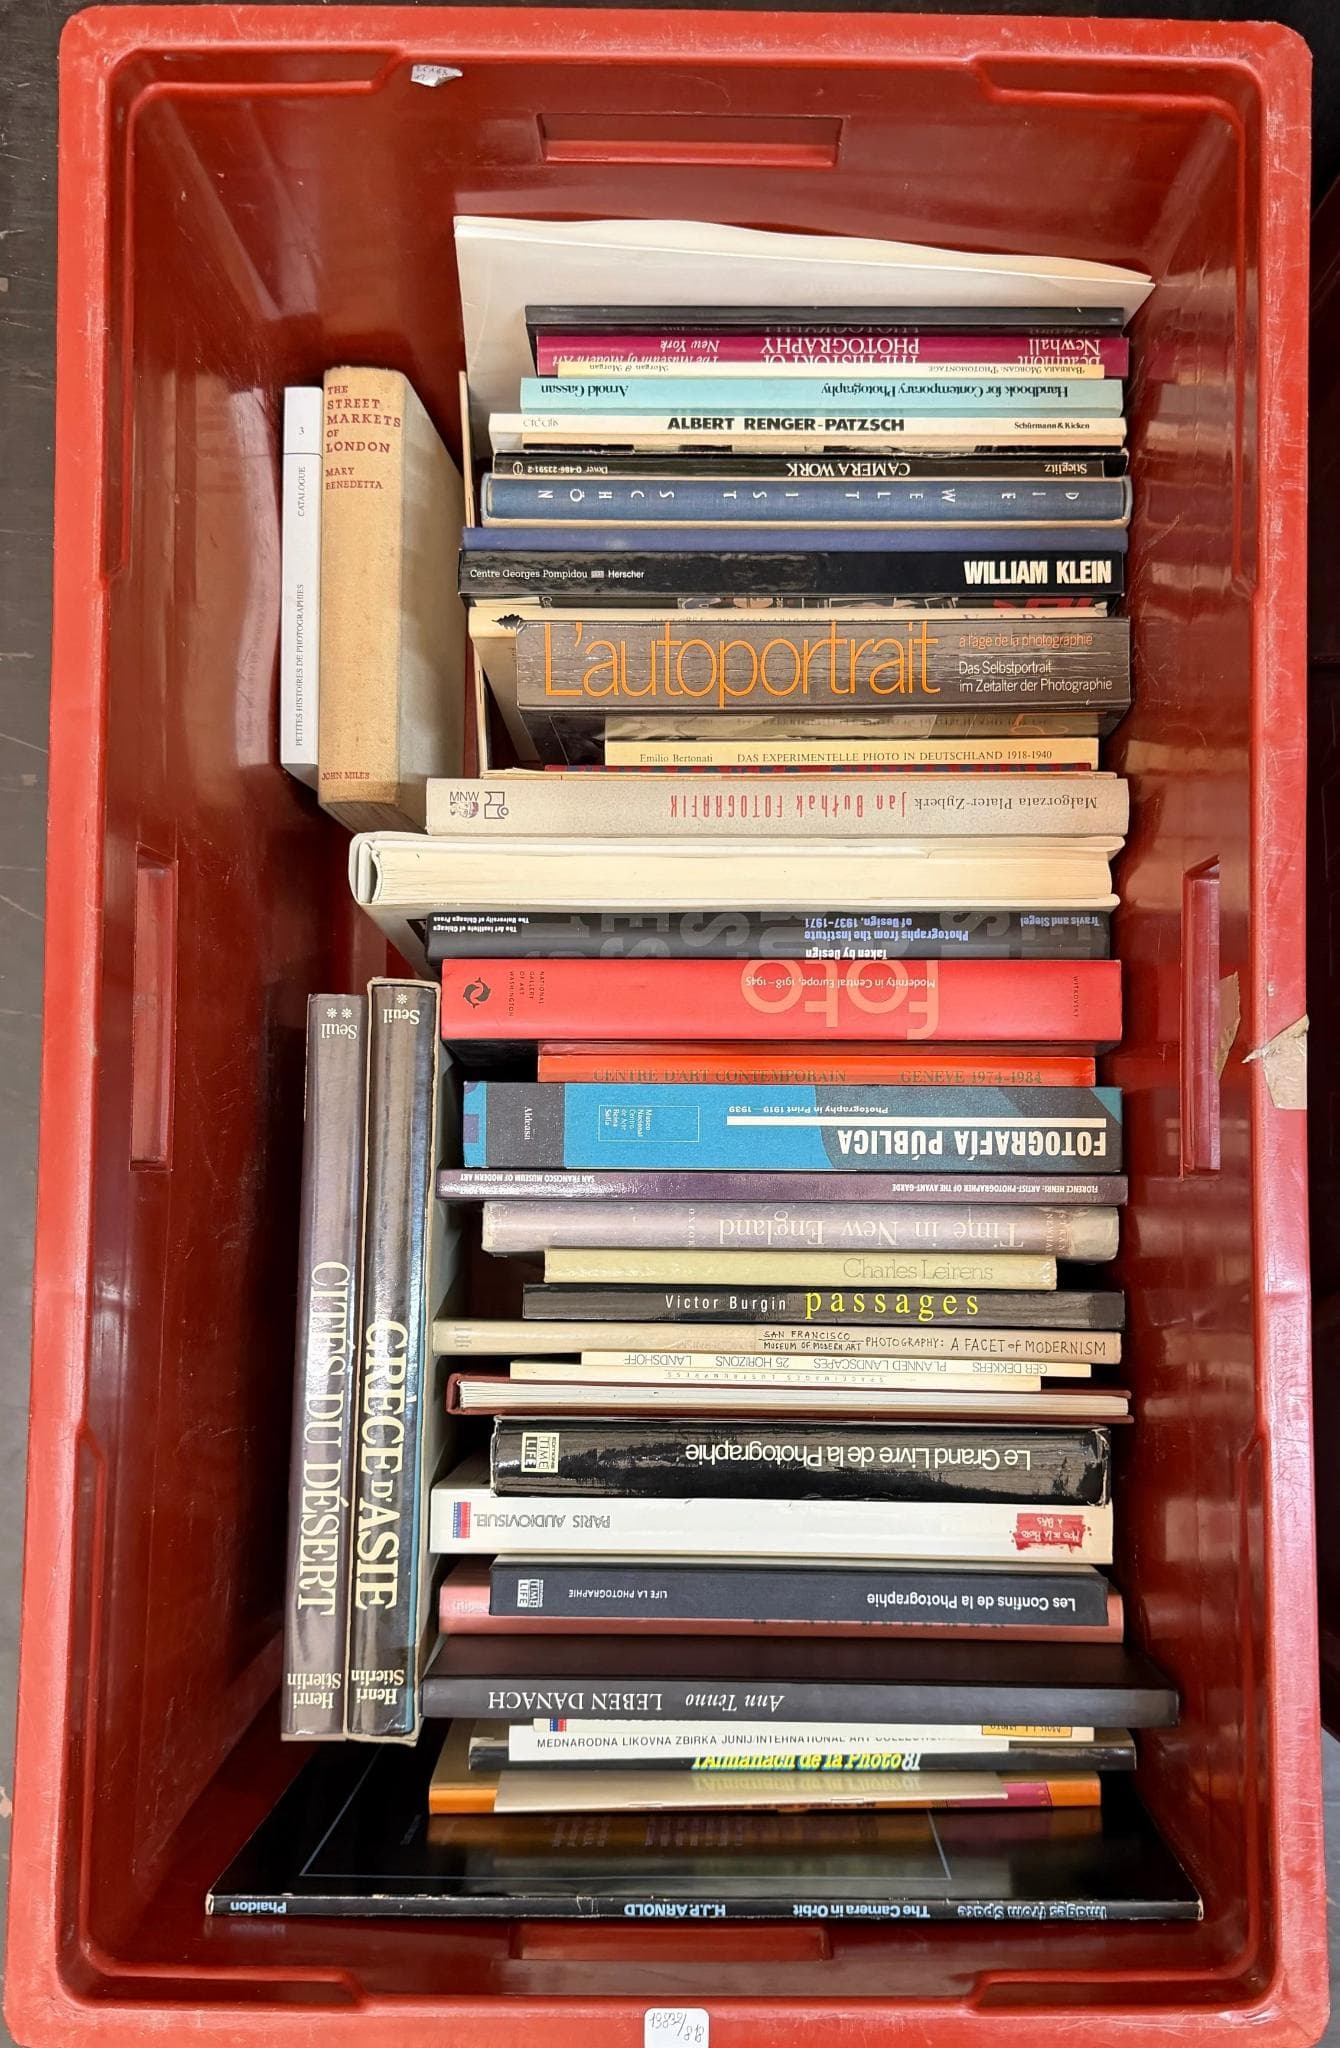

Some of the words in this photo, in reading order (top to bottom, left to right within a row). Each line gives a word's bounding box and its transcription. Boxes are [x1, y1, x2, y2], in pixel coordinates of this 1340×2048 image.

[660, 339, 686, 351] York
[691, 339, 719, 351] New
[760, 337, 920, 354] PHOTOGRAPHY
[1029, 337, 1101, 355] Newhall
[328, 386, 348, 394] THE
[541, 385, 584, 396] Gassan
[588, 385, 628, 397] Arnold
[822, 383, 896, 397] Photography
[898, 383, 983, 397] Contemporary
[986, 385, 1001, 398] for
[1005, 385, 1068, 398] Handbook
[328, 399, 380, 409] STREET
[327, 414, 401, 427] MARKETS
[668, 418, 734, 430] ALBERT
[744, 418, 905, 432] RENGER-PATZSCH
[327, 441, 391, 453] LONDON
[325, 467, 355, 477] MARY
[786, 463, 834, 476] WORK
[839, 463, 910, 476] CAMERA
[1045, 463, 1087, 474] Stieglitz
[297, 467, 306, 516] CATALOGUE
[326, 481, 383, 490] BENEDETTA
[470, 569, 500, 578] Centre
[502, 569, 540, 580] Georges
[543, 569, 587, 580] Pompidou
[608, 569, 644, 578] Herscher
[964, 561, 1047, 584] WILLIAM
[1056, 561, 1112, 584] KLEIN
[296, 584, 305, 652] PHOTOGRAPHIES
[296, 654, 304, 666] DE
[959, 661, 979, 674] Das
[982, 660, 1052, 675] Selbstportrait
[295, 668, 304, 711] HISTOIRES
[959, 681, 973, 692] im
[976, 679, 1017, 692] Zeitalter
[1020, 679, 1038, 692] der
[1040, 678, 1112, 692] Photographie
[295, 713, 304, 746] PETITES
[640, 754, 669, 762] Emilio
[673, 754, 713, 762] Bertonati
[738, 754, 759, 762] DAS
[762, 752, 859, 762] EXPERIMENTELLE
[863, 752, 900, 761] PHOTO
[904, 752, 915, 760] IN
[920, 751, 1003, 760] DEUTSCHLAND
[1007, 750, 1052, 760] 1918-1940
[450, 792, 479, 801] MNW
[914, 795, 1013, 809] Plater-Zyberk
[1019, 795, 1097, 809] Małgorzata
[669, 795, 782, 818] FOTOGRAFIK
[796, 795, 863, 818] Bułhak
[876, 791, 906, 817] Jan
[901, 918, 912, 928] of
[1020, 916, 1050, 927] Siegel
[1052, 916, 1069, 927] and
[1071, 916, 1099, 927] Travis
[805, 931, 851, 941] Institute
[854, 931, 871, 941] the
[874, 931, 898, 941] from
[901, 930, 968, 941] Photographs
[805, 947, 841, 959] Design
[843, 947, 855, 960] by
[858, 949, 887, 960] Taken
[837, 979, 873, 988] Central
[875, 979, 884, 988] in
[886, 978, 935, 988] Modernity
[383, 1009, 420, 1024] Seuil
[321, 1023, 357, 1039] Seuil
[825, 1106, 889, 1114] Photography
[524, 1107, 533, 1140] Aldeasa
[837, 1130, 943, 1160] PÚBLICA
[955, 1131, 1107, 1160] FOTOGRAFÍA
[892, 1183, 938, 1192] AVANT-GARDE
[940, 1184, 952, 1192] THE
[954, 1184, 962, 1192] OF
[964, 1184, 1040, 1193] ARTIST-PHOTOGRAPHER
[1067, 1185, 1098, 1194] FLORENCE
[719, 1211, 825, 1246] England
[841, 1221, 898, 1246] New
[914, 1221, 938, 1246] in
[952, 1221, 1023, 1248] Time
[843, 1258, 918, 1281] Charles
[921, 1260, 994, 1281] Leirens
[665, 1295, 719, 1310] Victor
[729, 1296, 786, 1312] Burgin
[805, 1291, 980, 1321] passages
[307, 1261, 356, 1377] CITÉS
[866, 1336, 944, 1348] PHOTOGRAPHY:
[950, 1338, 959, 1351] A
[964, 1338, 1006, 1352] FACET
[1025, 1342, 1106, 1356] MODERNISM
[624, 1354, 691, 1366] LANDSHOFF
[715, 1356, 772, 1367] HORIZONS
[774, 1357, 790, 1368] 25
[813, 1358, 889, 1371] LANDSCAPES
[892, 1359, 946, 1372] PLANNED
[972, 1361, 1022, 1373] DEKKERS
[1023, 1362, 1047, 1373] GER
[360, 1320, 418, 1474] GRÈCE
[303, 1390, 344, 1448] DU
[685, 1440, 823, 1466] Photographie
[826, 1446, 844, 1467] la
[848, 1446, 875, 1469] de
[879, 1447, 929, 1469] Livre
[934, 1448, 1000, 1471] Grand
[1004, 1449, 1031, 1471] Le
[473, 1513, 566, 1528] AUDIOVISUEL
[572, 1514, 611, 1529] PARIS
[298, 1460, 350, 1616] DÉSERT
[355, 1479, 402, 1611] D'ASIE
[568, 1588, 635, 1599] PHOTOGRAPHIE
[637, 1589, 647, 1599] LA
[649, 1590, 668, 1599] LIFE
[867, 1592, 957, 1609] Photographie
[961, 1595, 974, 1609] la
[977, 1596, 994, 1609] de
[998, 1596, 1049, 1610] Confins
[1053, 1597, 1076, 1611] Les
[287, 1673, 341, 1689] Stierlin
[351, 1669, 404, 1685] Stierlin
[293, 1692, 333, 1709] Henri
[356, 1688, 397, 1705] Henri
[488, 1691, 584, 1710] DANACH
[591, 1692, 662, 1711] LEBEN
[685, 1693, 738, 1712] Tenno
[744, 1693, 784, 1712] Ann
[537, 1738, 618, 1748] MEDNARODNA
[623, 1737, 671, 1746] LIKOVNA
[676, 1736, 716, 1745] ZBIRKA
[230, 1901, 287, 1914] Phaidon
[793, 1904, 828, 1918] Orbit
[831, 1904, 844, 1918] in
[846, 1904, 901, 1918] Camera
[904, 1905, 930, 1918] The
[957, 1904, 1004, 1919] Space
[1007, 1905, 1046, 1920] from
[1049, 1903, 1107, 1920] Images
